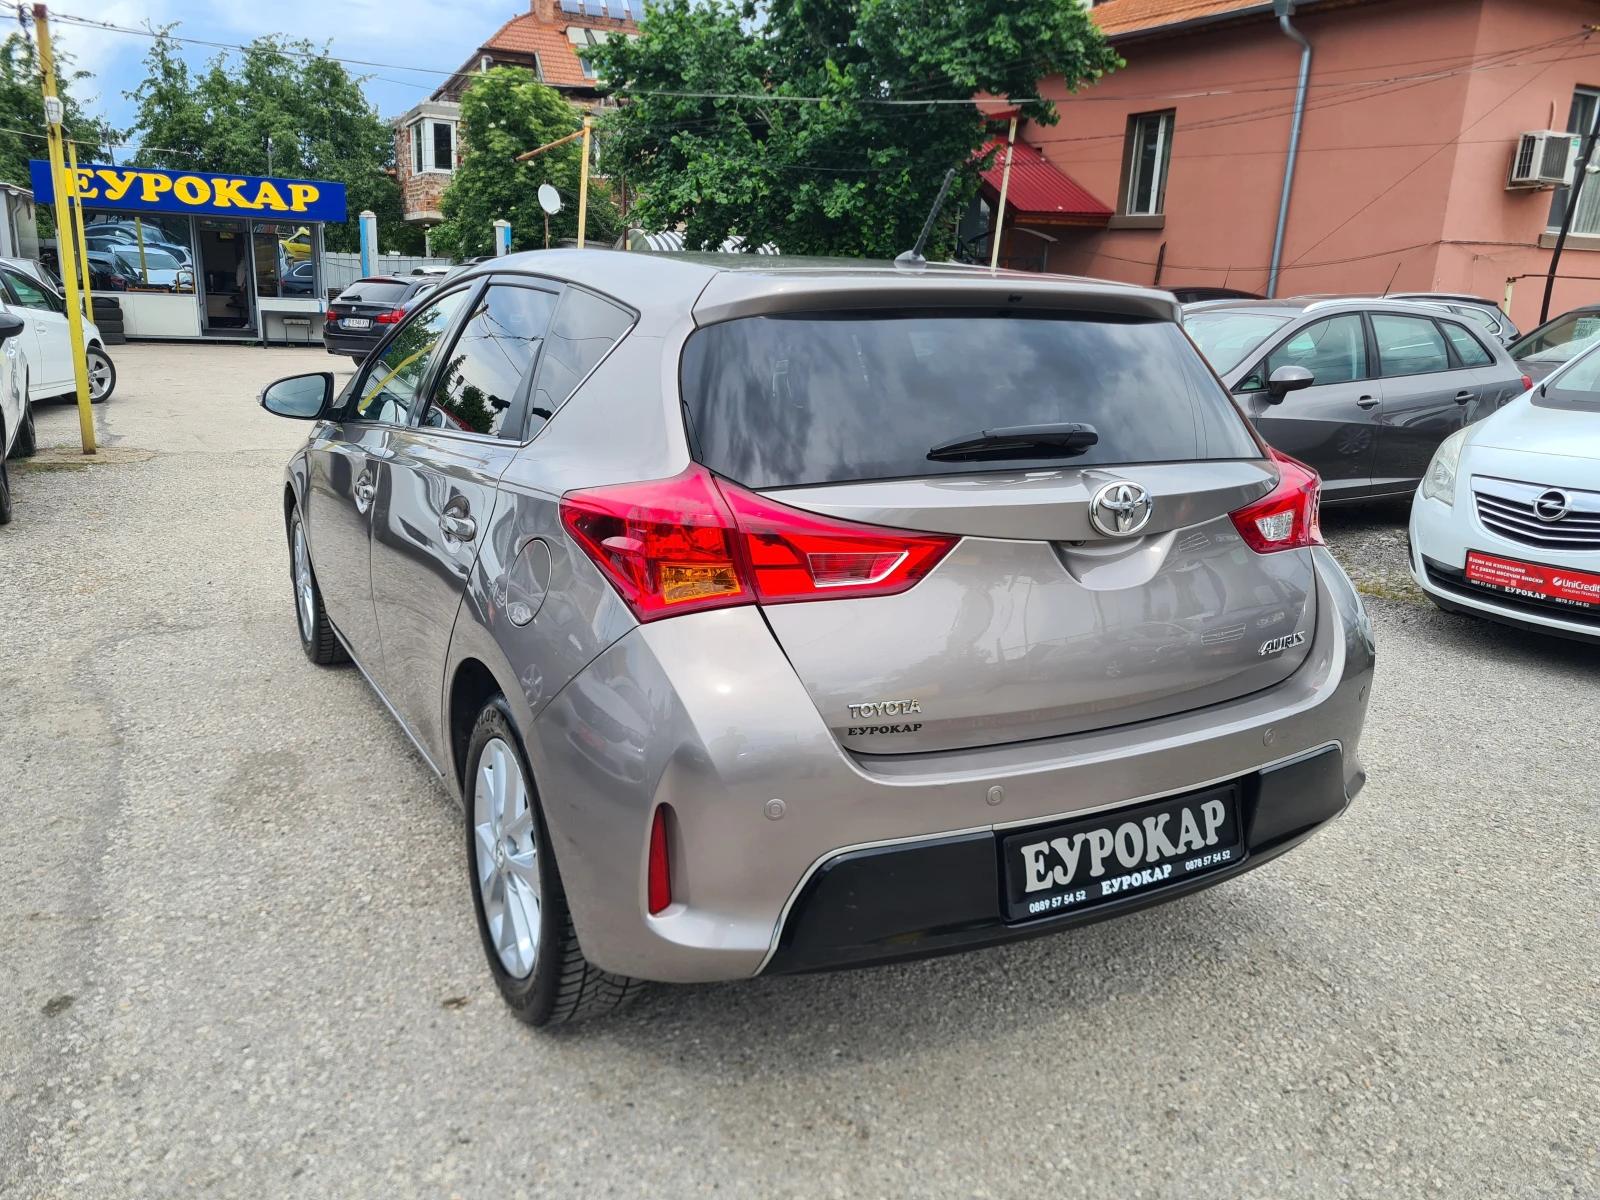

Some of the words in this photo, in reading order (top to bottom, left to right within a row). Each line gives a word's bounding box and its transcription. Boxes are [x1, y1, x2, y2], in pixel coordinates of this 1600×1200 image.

[63, 166, 320, 212] ЕУРОКАР
[1504, 585, 1546, 600] ЕУРОКАР
[1562, 578, 1600, 593] UniCredit
[1258, 630, 1305, 655] AURIS
[847, 699, 922, 719] TOYOTA
[847, 723, 923, 736] ЕУРОКАР
[1021, 799, 1226, 893] ЕУРОКАР
[1028, 899, 1050, 914] 0889
[1051, 896, 1062, 908] 57
[1063, 893, 1075, 905] 54
[1075, 890, 1087, 902] 52
[1101, 863, 1173, 896] ЕУРОКАР
[1185, 857, 1203, 871] 0878
[1203, 855, 1212, 867] 57
[1212, 852, 1222, 864] 54
[1221, 849, 1231, 861] 52
